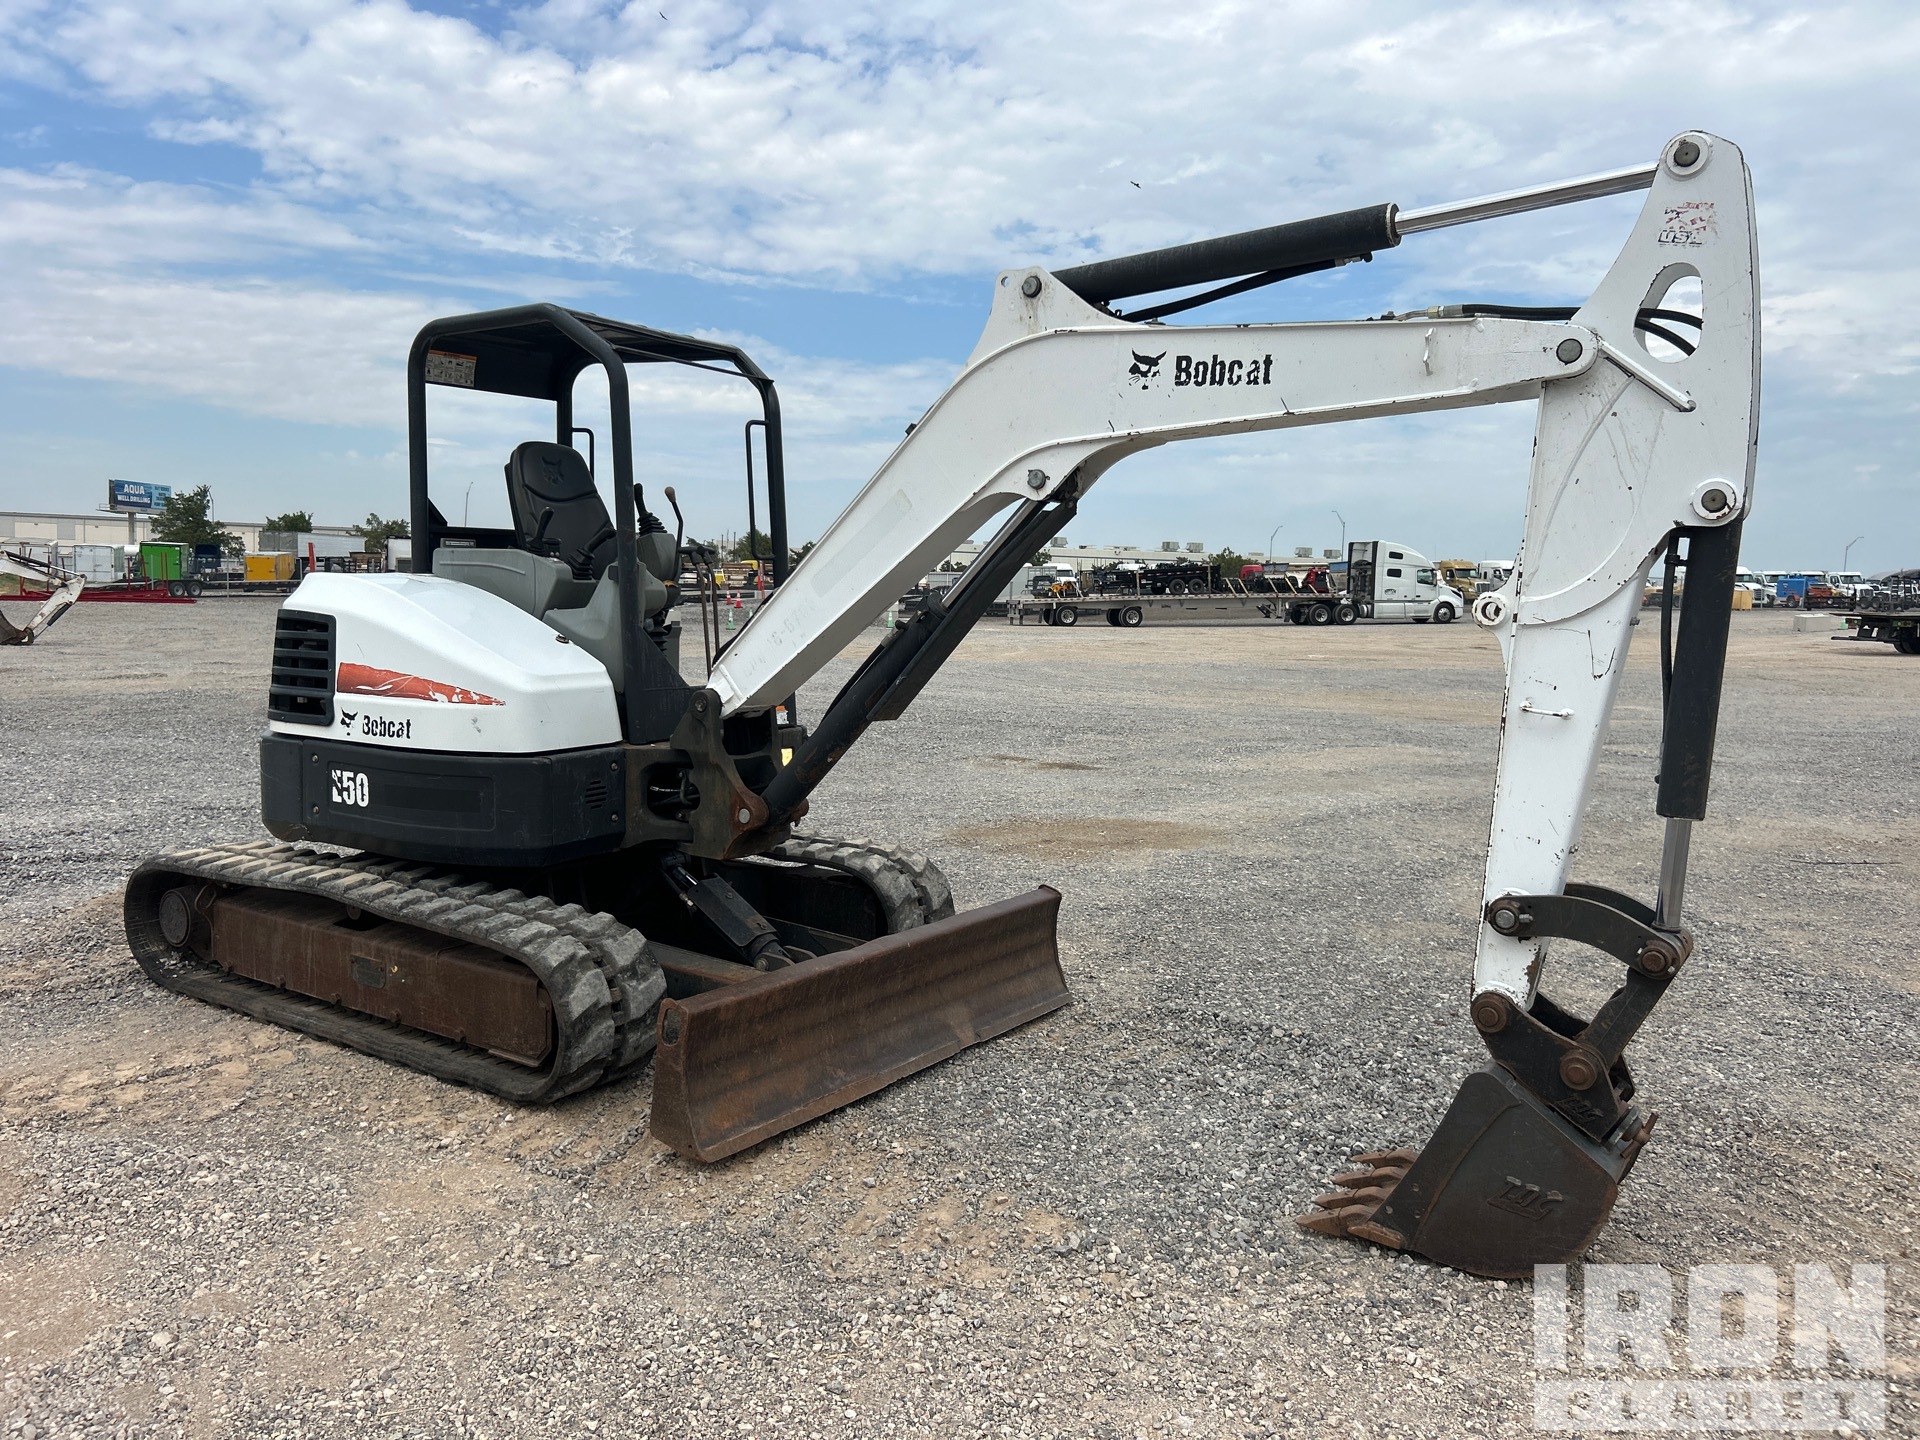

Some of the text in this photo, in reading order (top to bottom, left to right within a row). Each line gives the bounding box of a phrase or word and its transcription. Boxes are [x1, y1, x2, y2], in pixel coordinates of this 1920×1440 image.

[1174, 354, 1273, 387] Bobcat
[123, 484, 144, 494] AQUA
[362, 715, 412, 739] Bobcat
